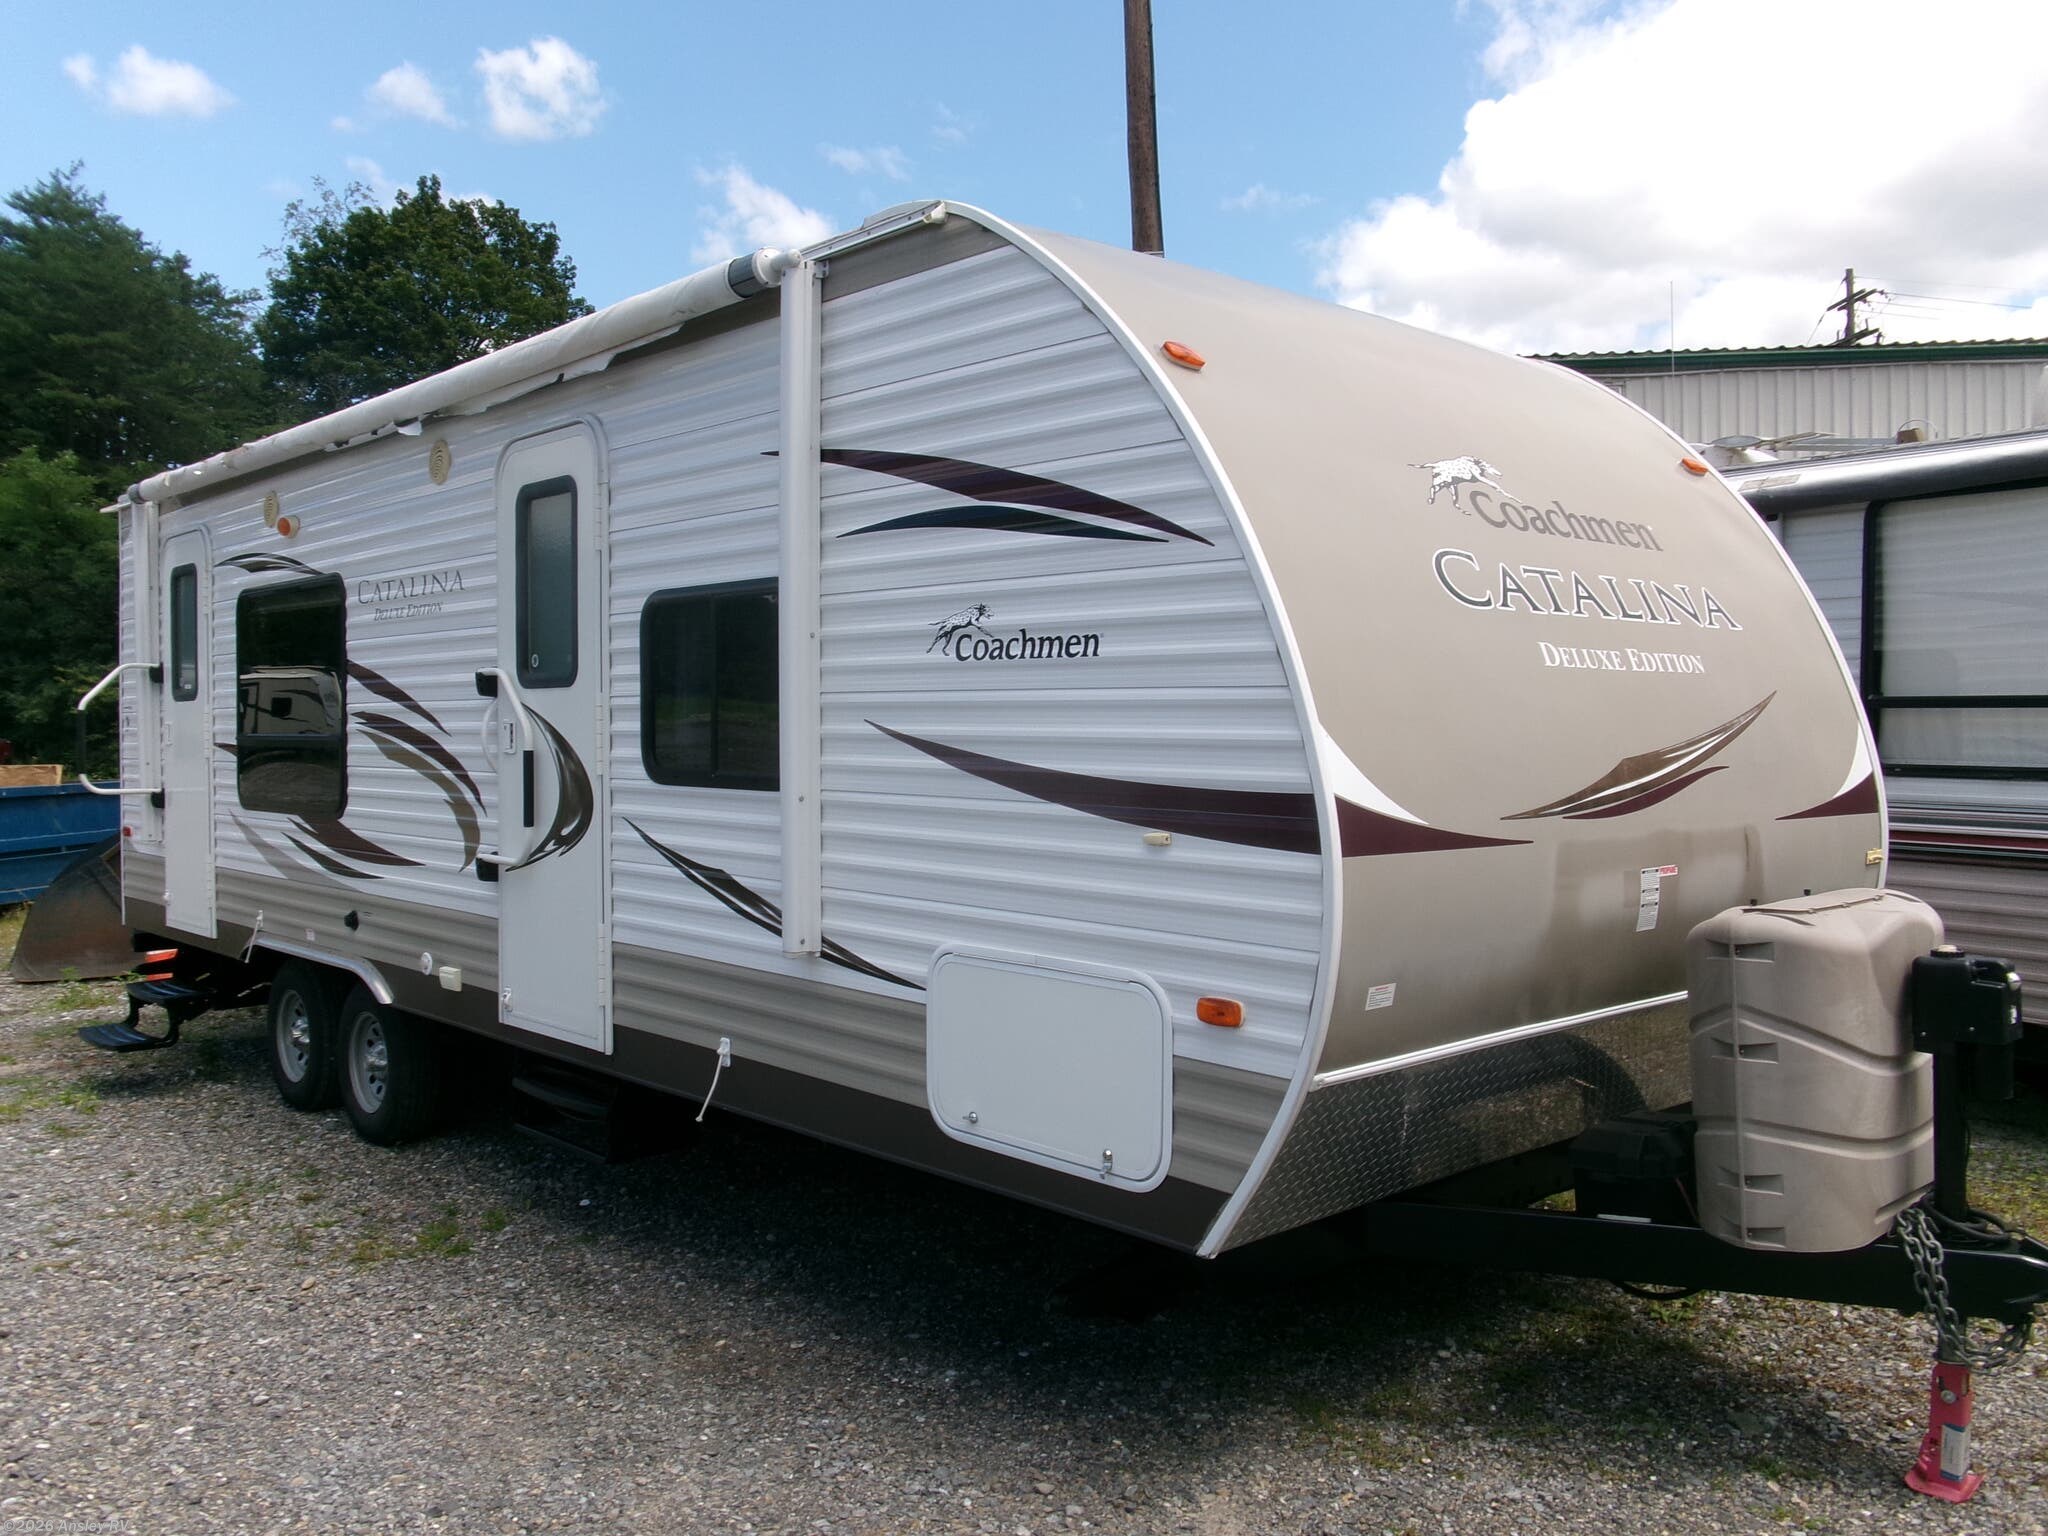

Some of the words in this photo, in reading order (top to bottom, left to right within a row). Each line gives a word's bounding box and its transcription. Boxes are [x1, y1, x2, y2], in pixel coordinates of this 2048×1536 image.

[1469, 490, 1664, 551] Coachmen
[358, 569, 465, 604] CATALINA
[1432, 548, 1743, 631] CATALINA
[955, 628, 1100, 662] Coachmen
[1536, 641, 1627, 672] DELUXE
[1626, 648, 1705, 674] EDITION
